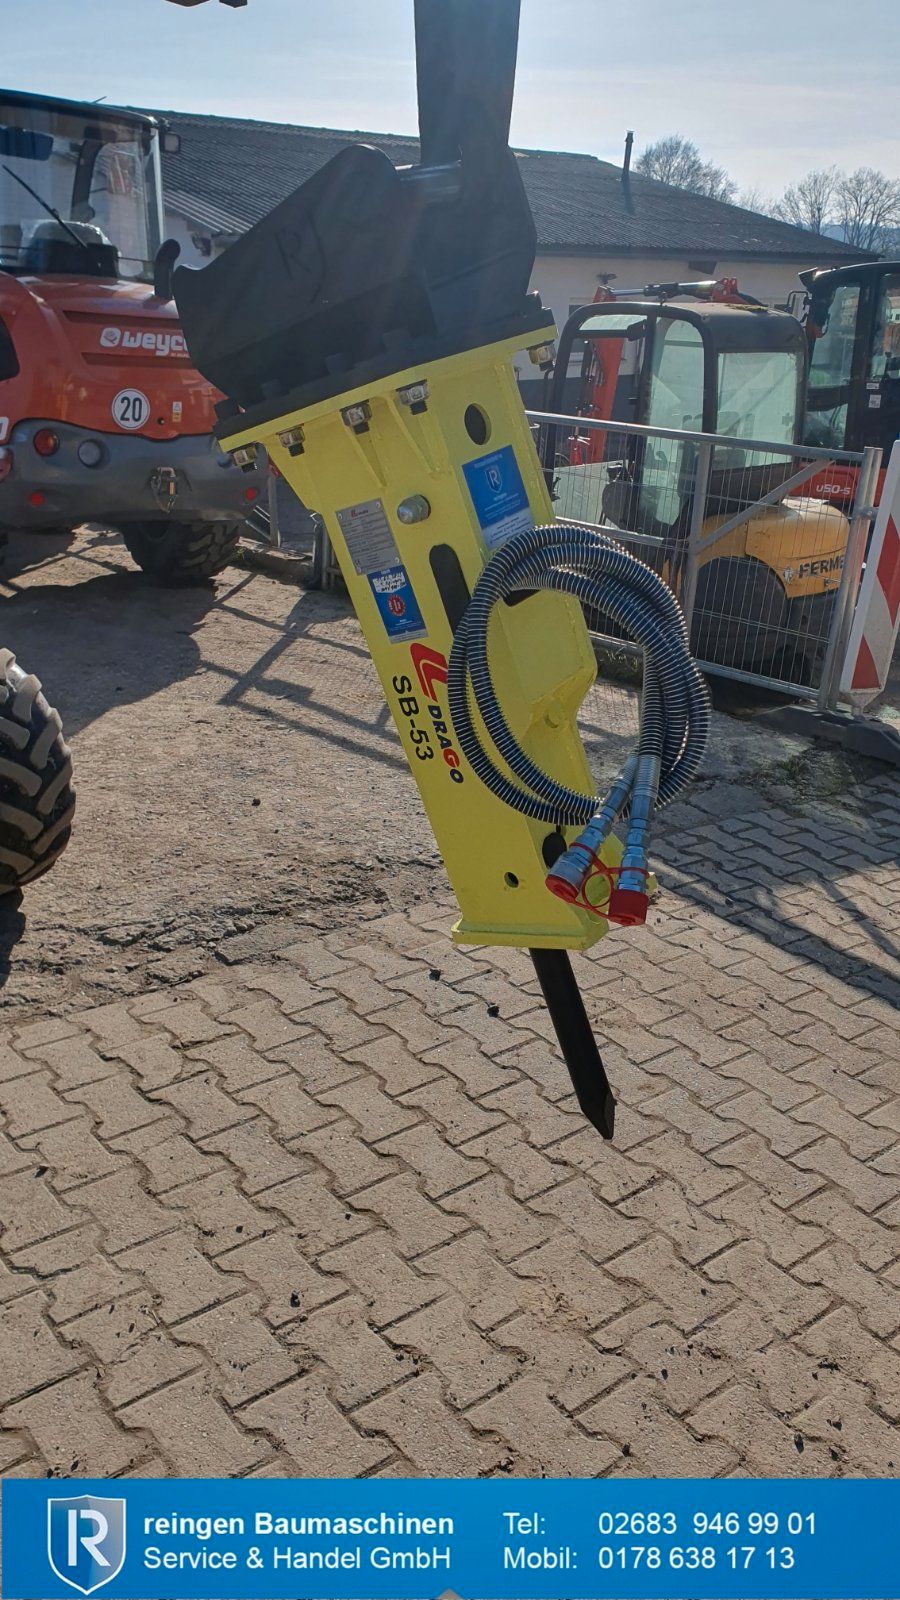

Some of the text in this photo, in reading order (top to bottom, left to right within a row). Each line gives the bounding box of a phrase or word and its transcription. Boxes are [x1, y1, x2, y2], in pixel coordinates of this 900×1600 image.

[119, 396, 143, 423] 20
[392, 675, 434, 761] SB-53
[428, 704, 464, 784] DRAGO
